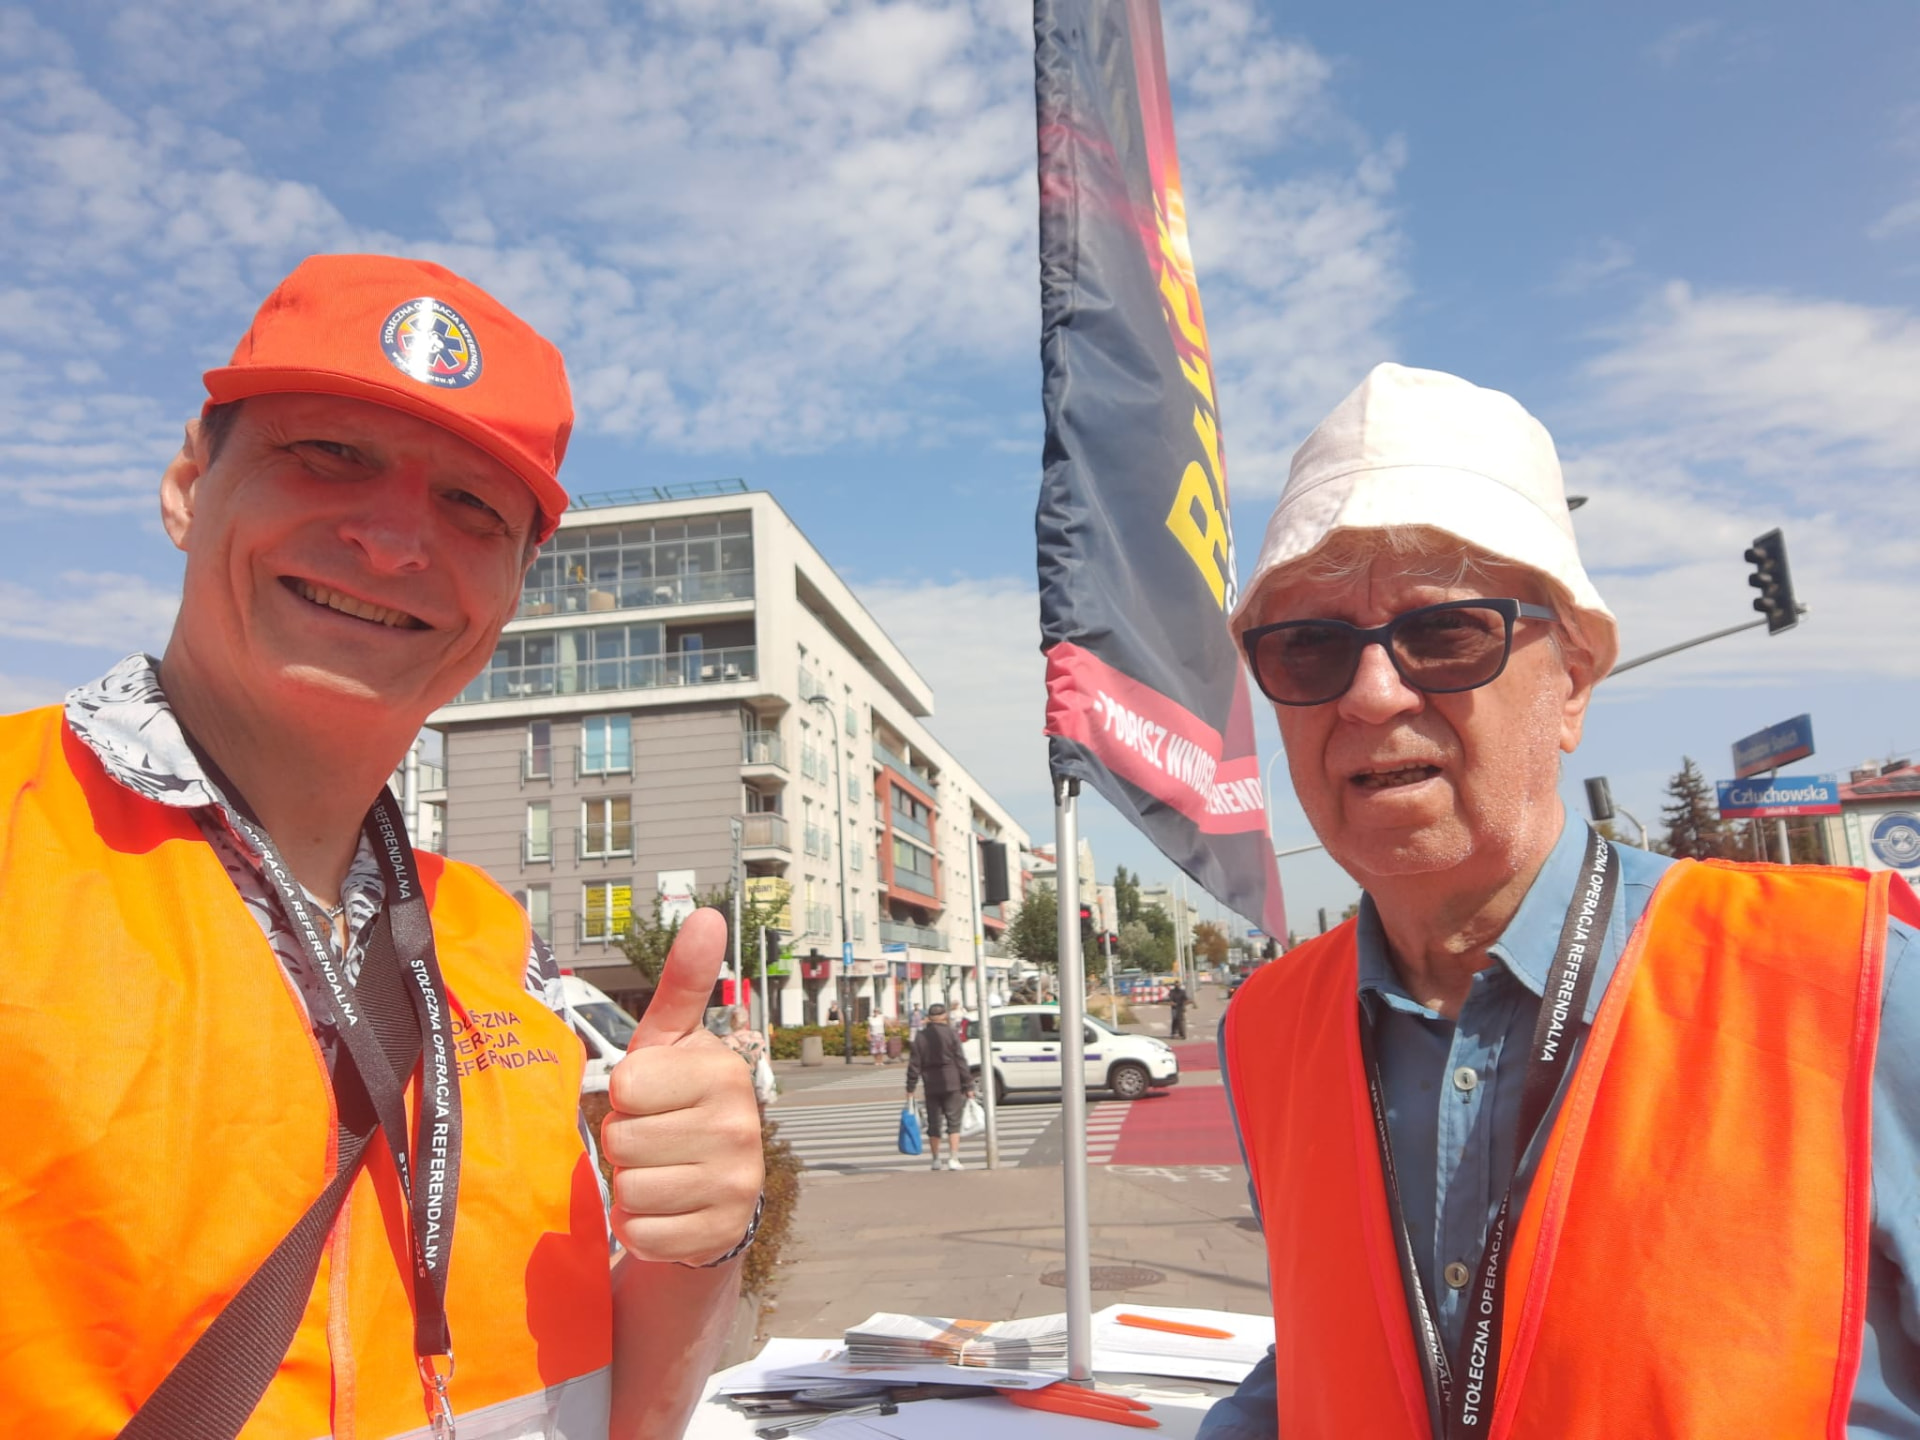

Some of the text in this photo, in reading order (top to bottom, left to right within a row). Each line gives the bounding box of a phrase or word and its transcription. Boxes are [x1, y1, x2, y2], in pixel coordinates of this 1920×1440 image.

[374, 805, 412, 900] REFERENDALNA
[1730, 784, 1829, 805] Człuchowska
[291, 900, 359, 1027] REFERENDALNA
[1574, 873, 1605, 941] OPERACJA
[1540, 942, 1586, 1062] REFERENDALNA
[410, 959, 450, 1270] STOŁECZNA OPERACJA REFERENDALNA
[1462, 1219, 1506, 1426] STOŁECZNA OPERACJA
